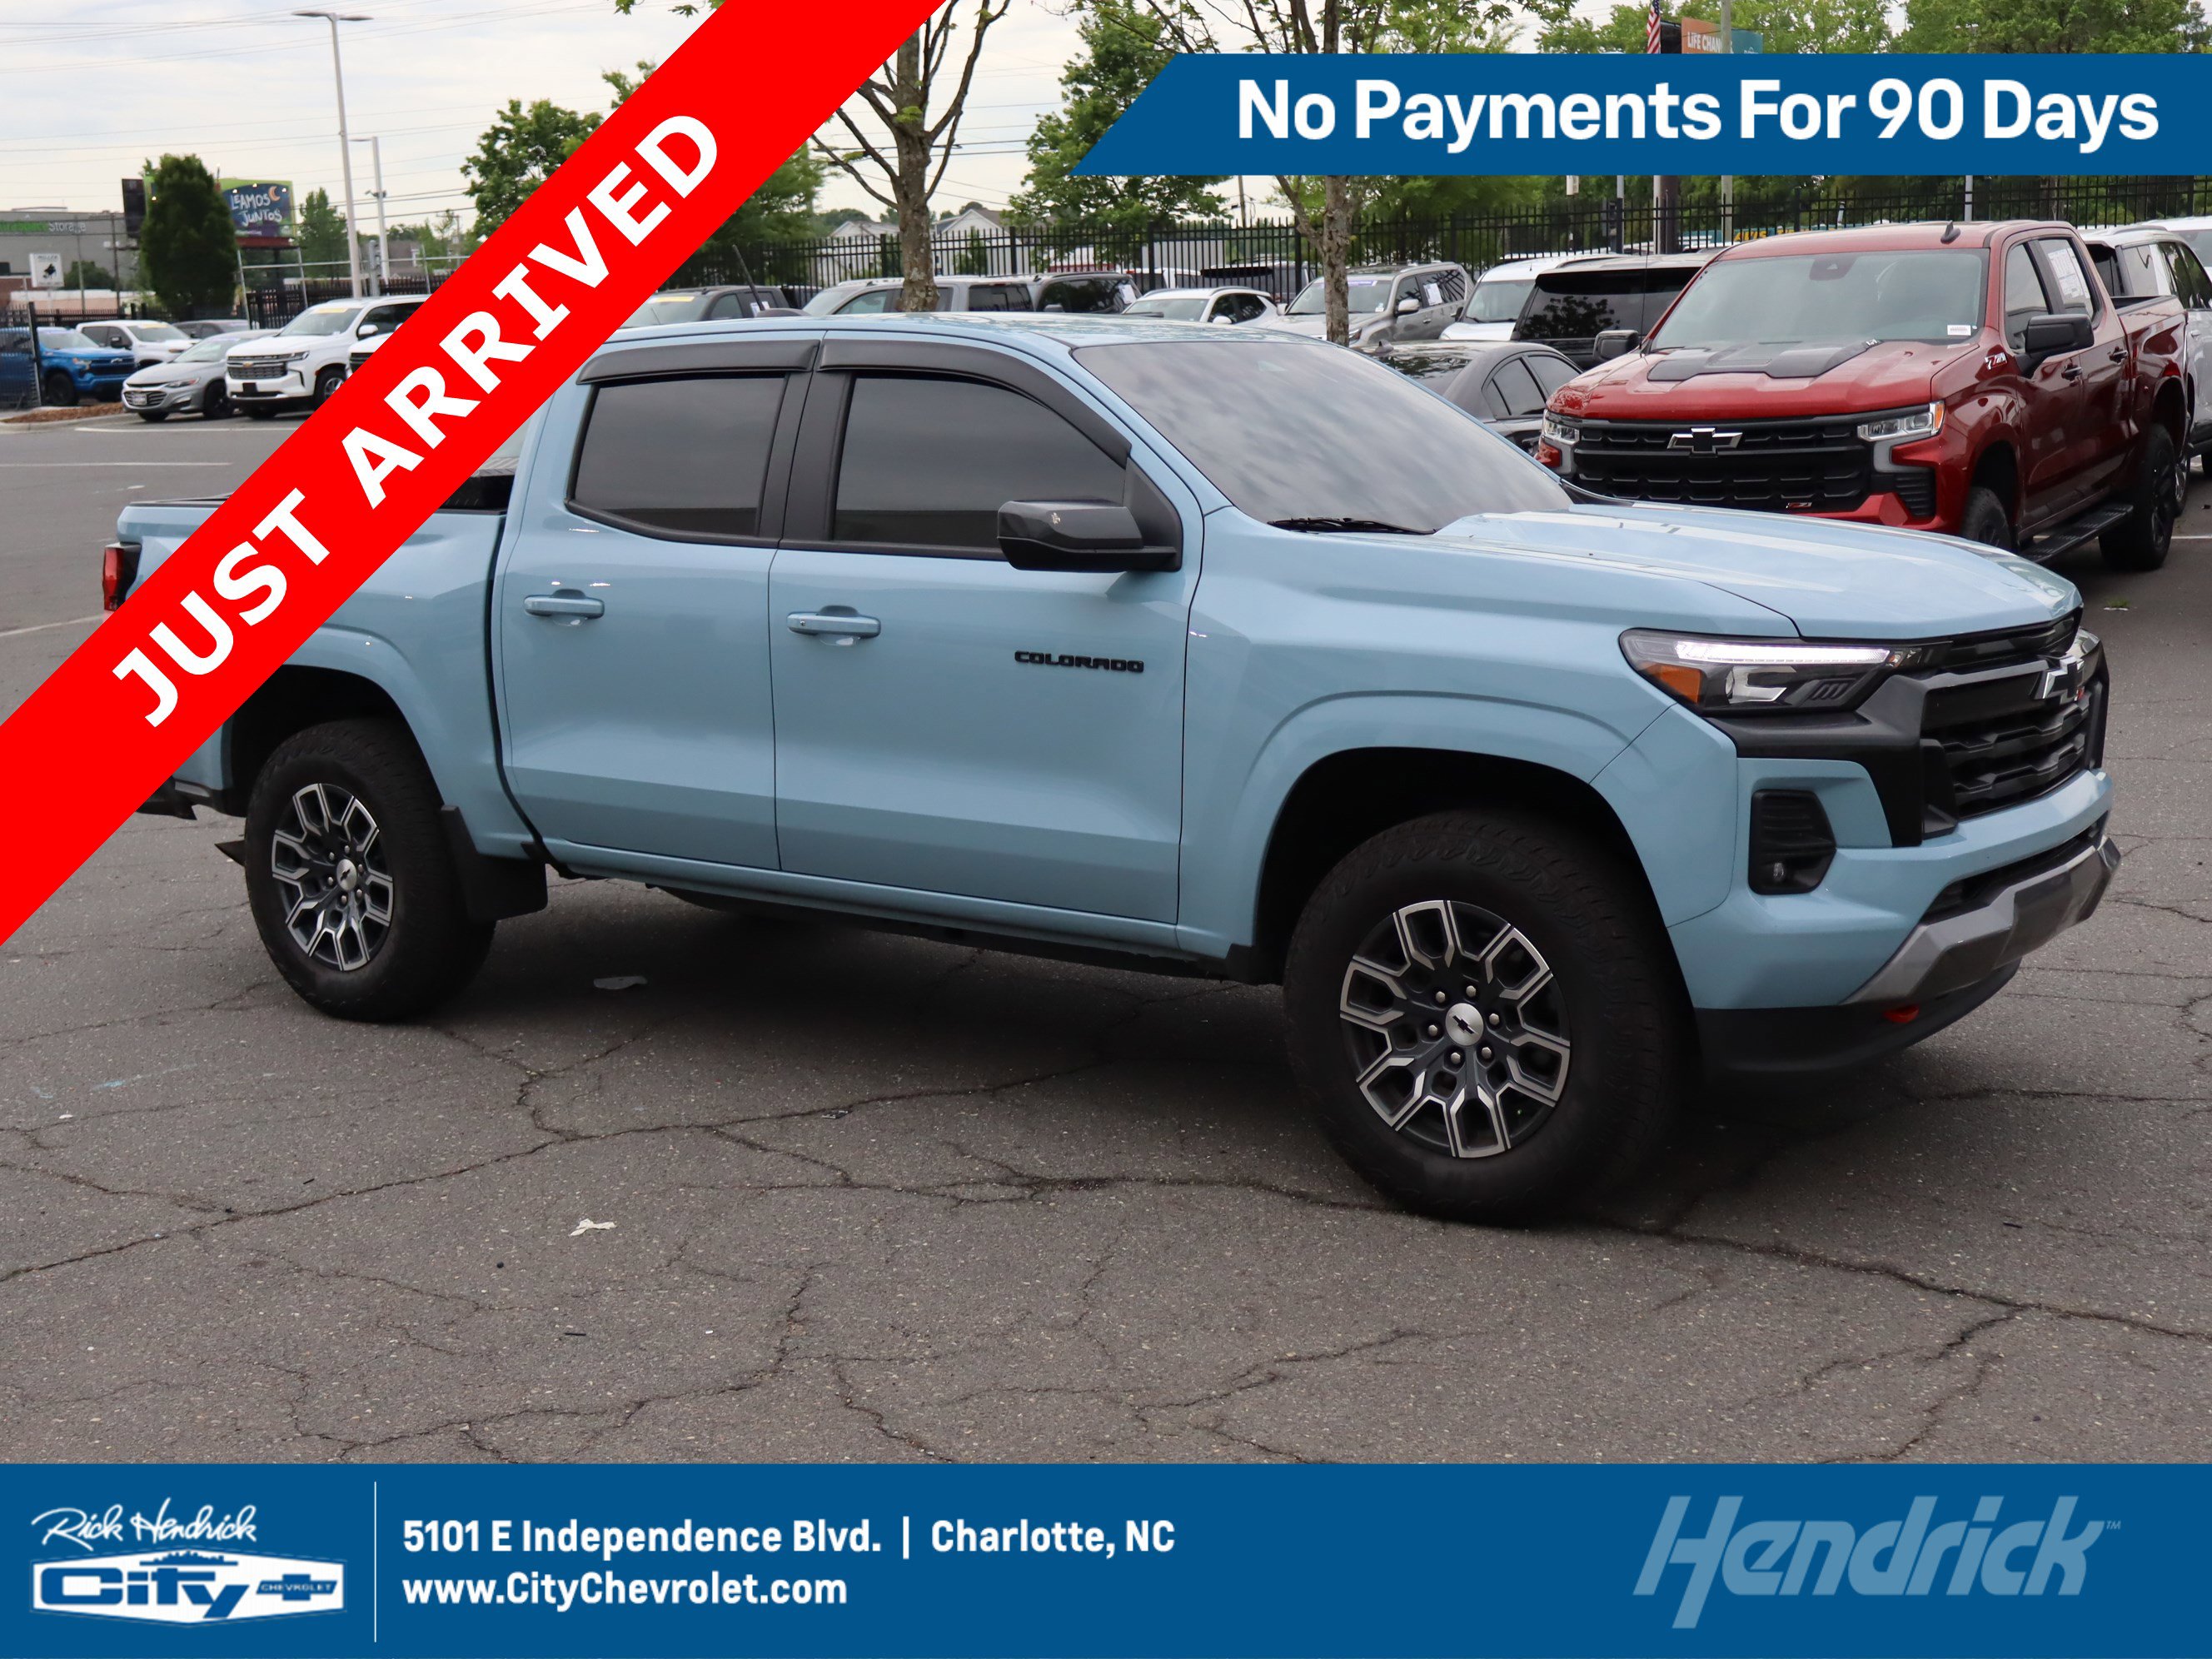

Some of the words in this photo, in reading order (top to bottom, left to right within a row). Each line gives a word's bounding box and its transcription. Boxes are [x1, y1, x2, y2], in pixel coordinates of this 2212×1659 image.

[1687, 32, 1701, 50] LIFE
[231, 193, 271, 210] LEAMOS
[237, 208, 282, 227] JUNTOS
[1014, 650, 1144, 673] COLORADO
